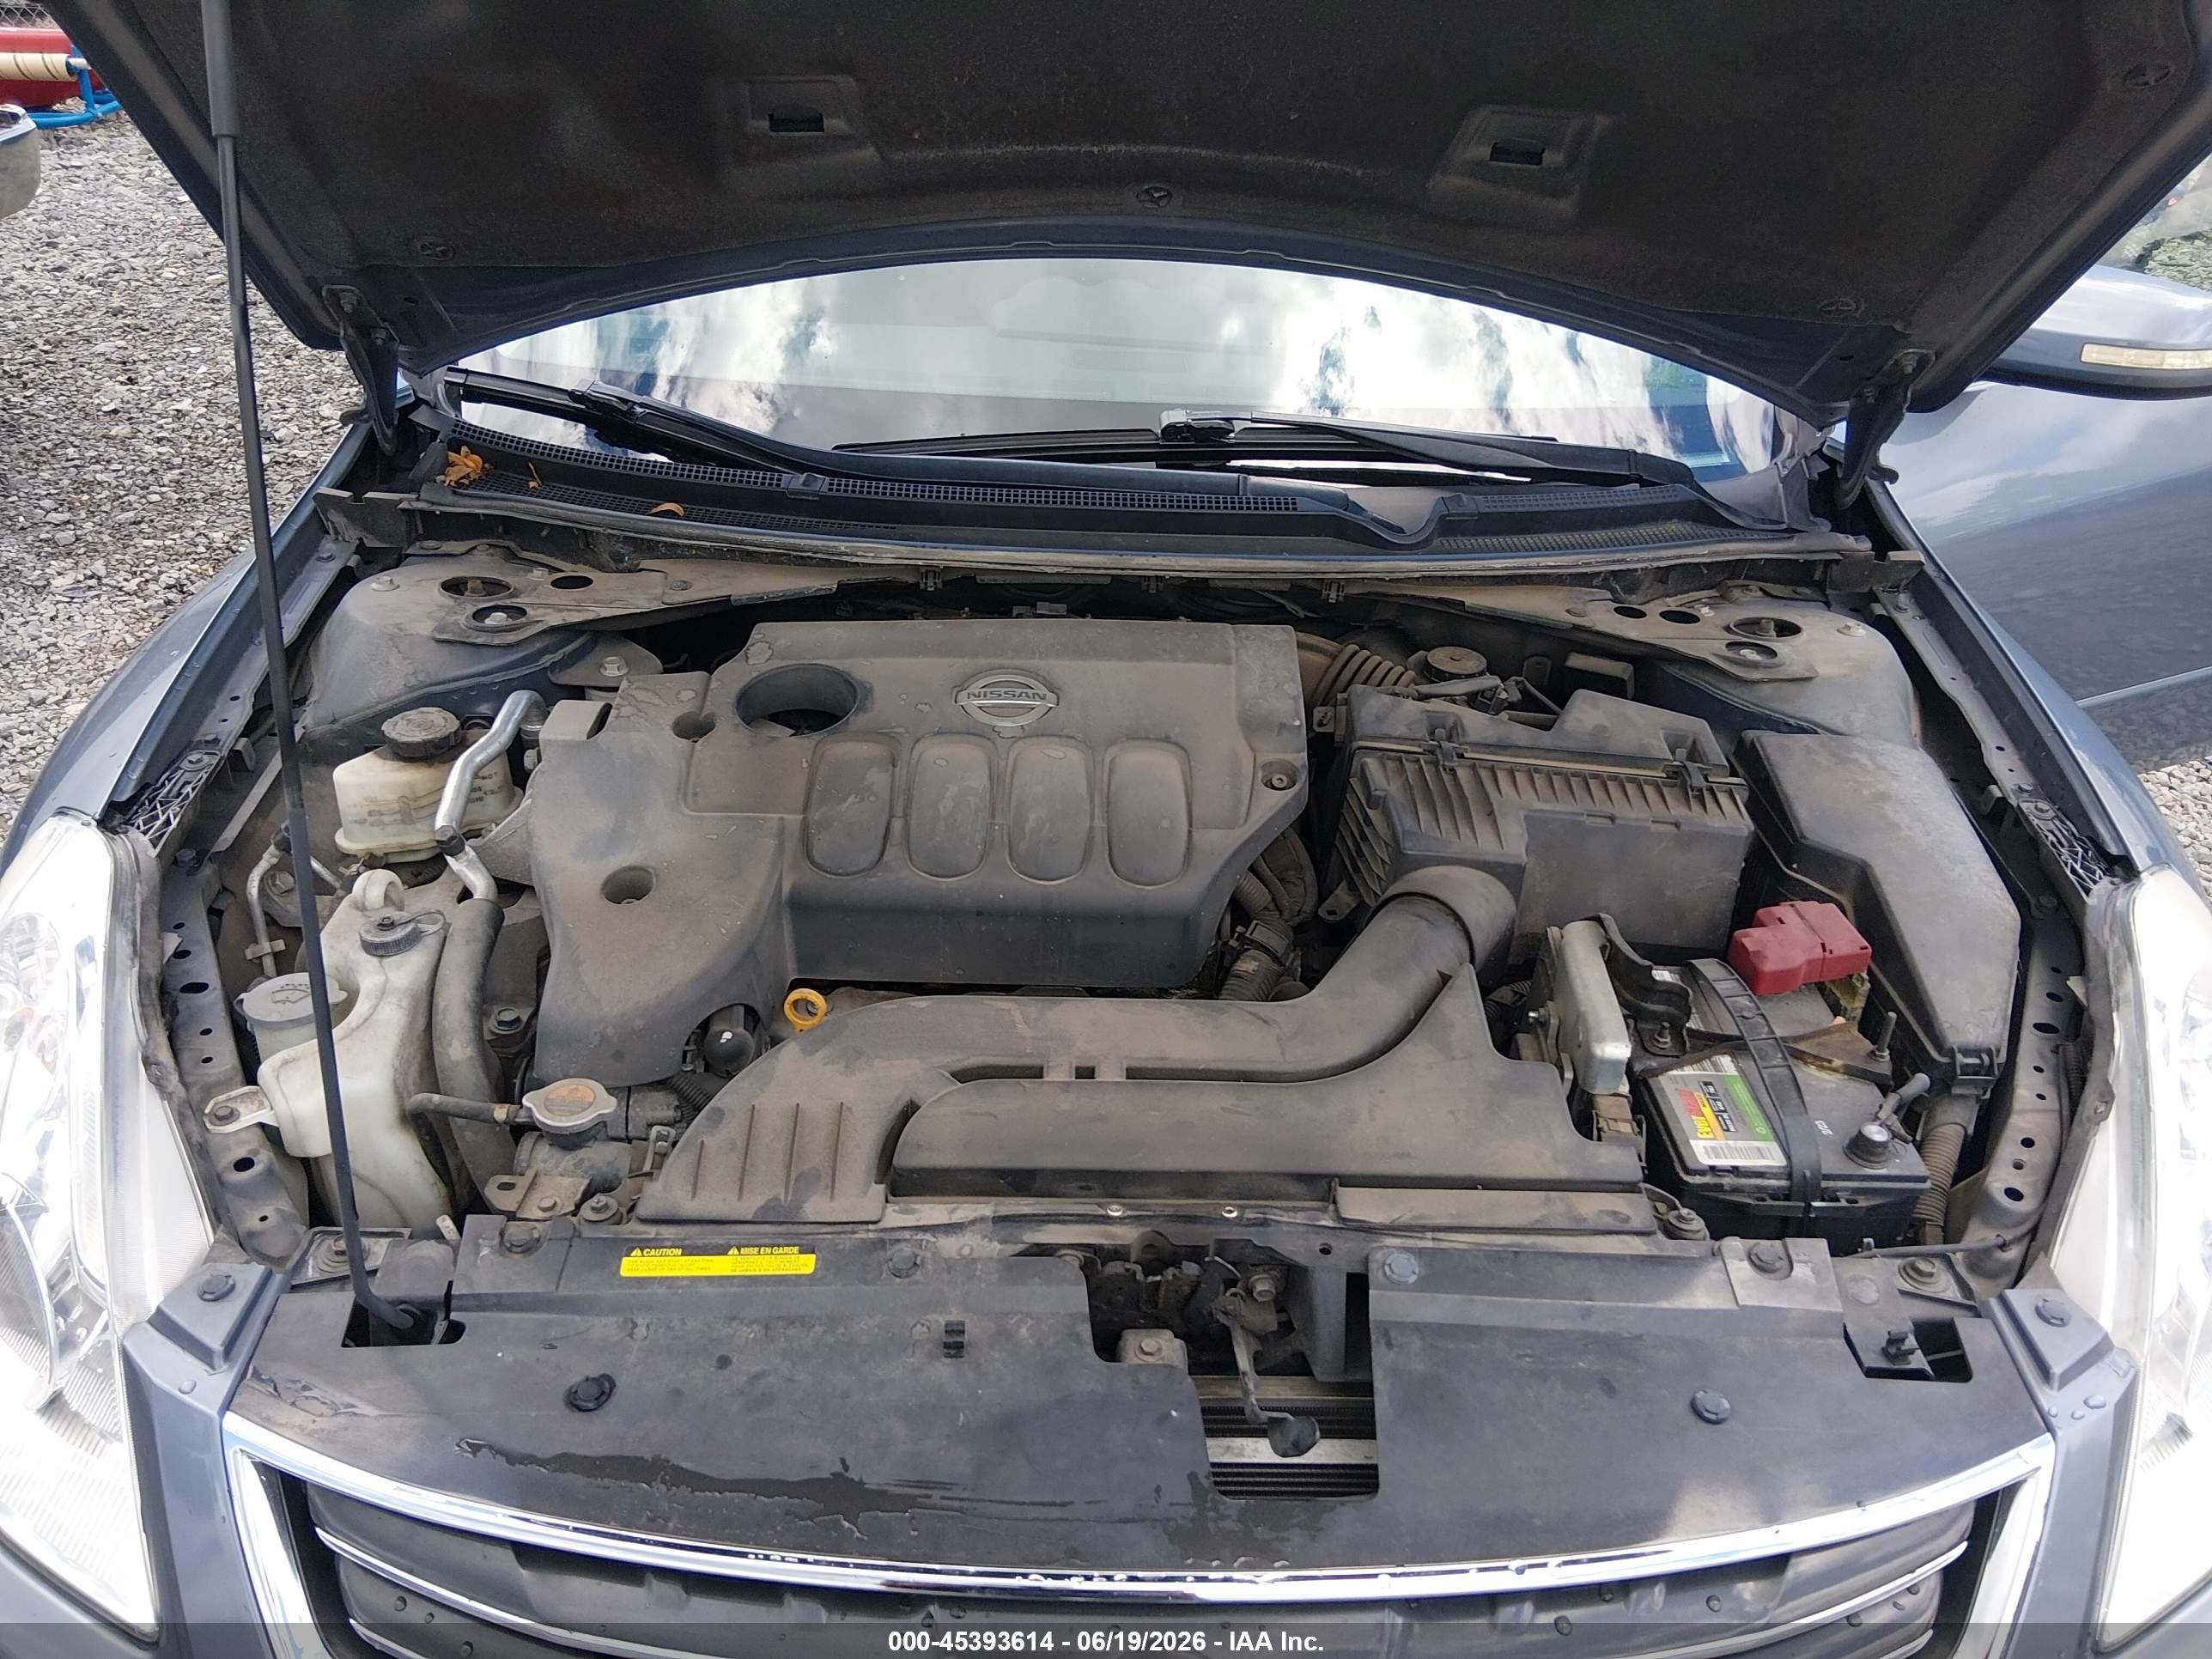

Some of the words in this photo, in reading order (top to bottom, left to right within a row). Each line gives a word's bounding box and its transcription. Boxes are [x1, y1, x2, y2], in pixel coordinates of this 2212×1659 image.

[967, 690, 1047, 700] NISSAN
[643, 1248, 683, 1256] CAUTION
[740, 1246, 760, 1255] MISE
[760, 1246, 772, 1255] EN
